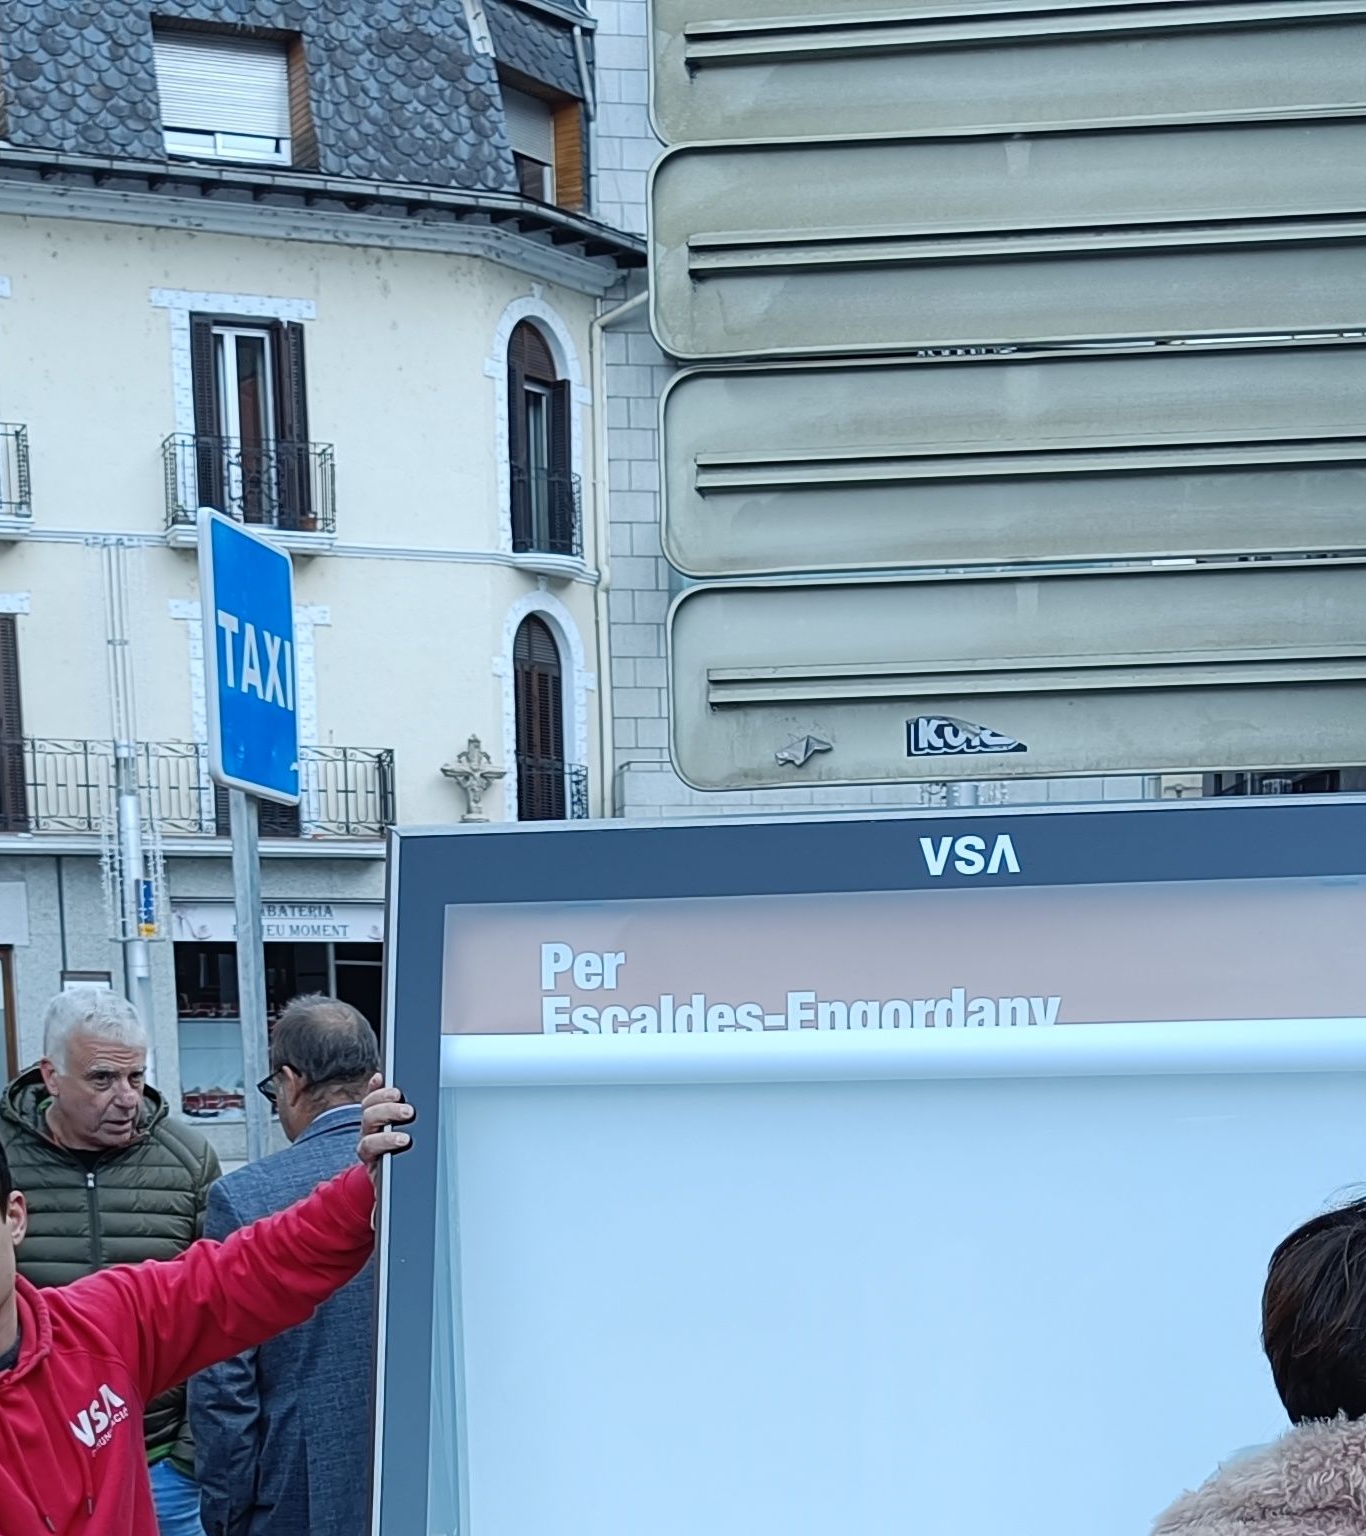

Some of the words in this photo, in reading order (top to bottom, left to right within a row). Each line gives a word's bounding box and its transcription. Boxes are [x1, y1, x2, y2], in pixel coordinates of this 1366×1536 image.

[217, 609, 294, 711] TAXI
[919, 834, 1021, 876] VSA
[260, 904, 334, 918] BATERIA
[263, 924, 285, 937] EU
[289, 924, 350, 937] MOMENT
[541, 942, 626, 990] Per
[69, 1384, 125, 1447] VSA
